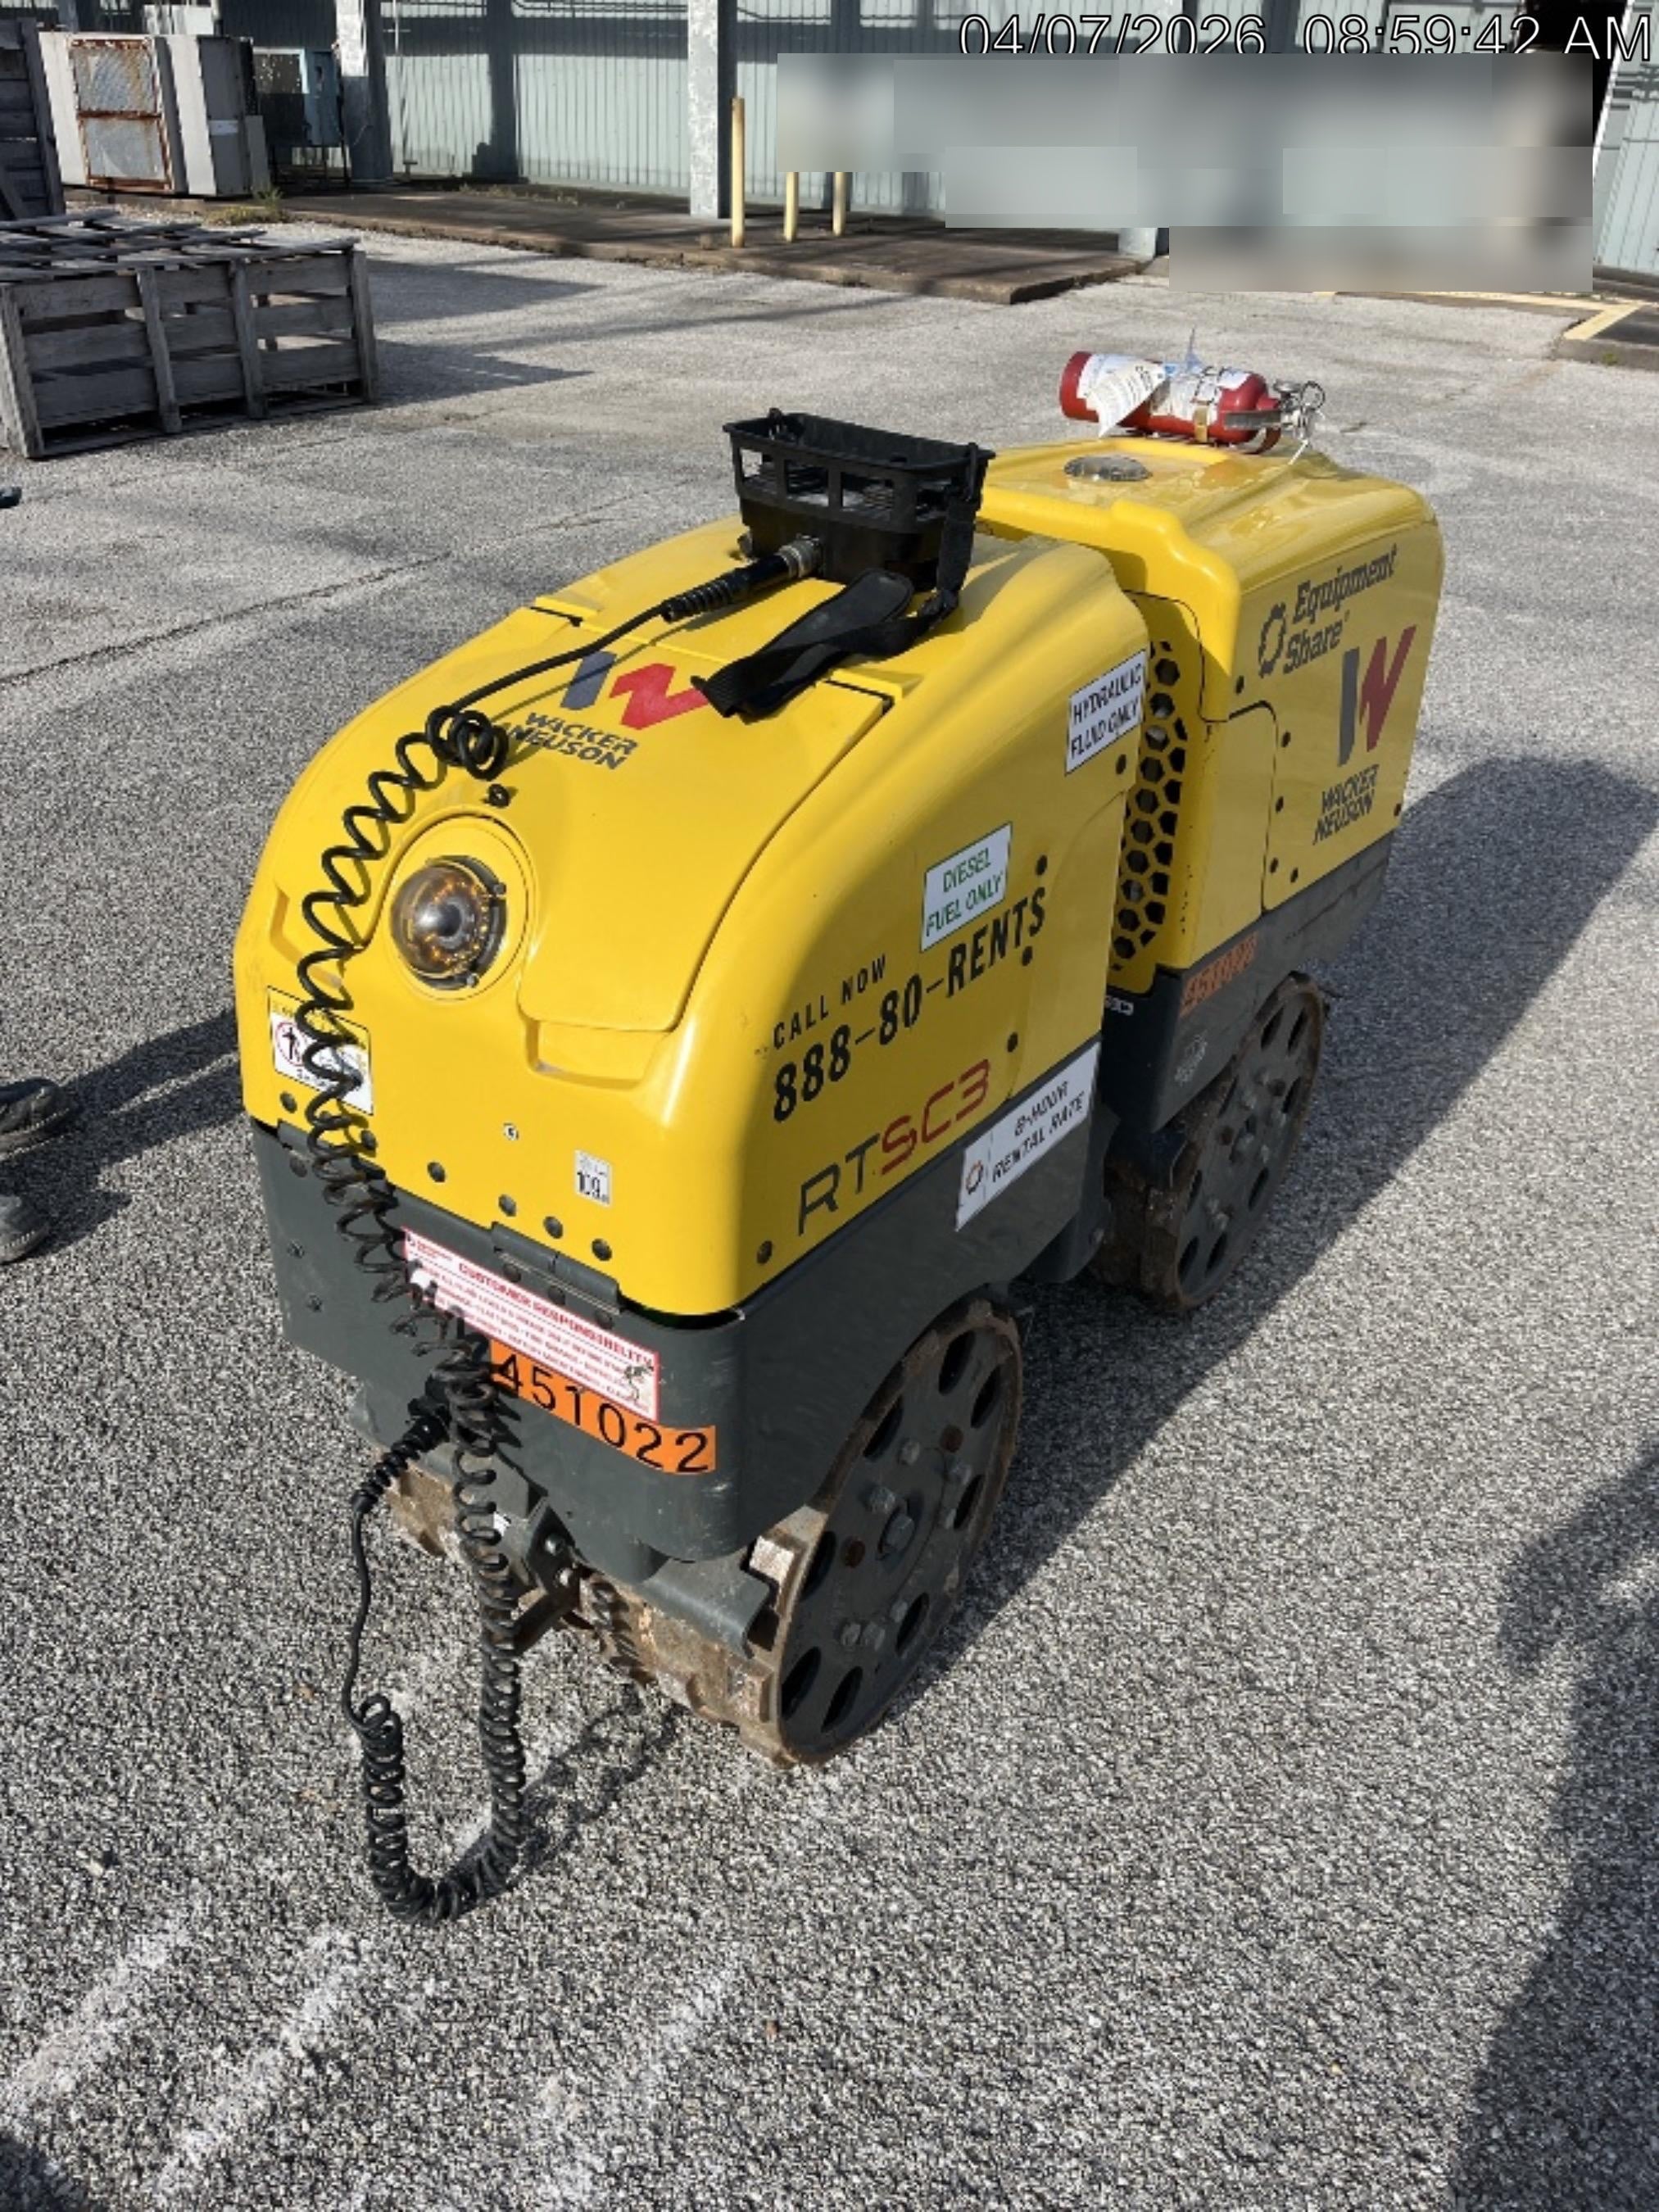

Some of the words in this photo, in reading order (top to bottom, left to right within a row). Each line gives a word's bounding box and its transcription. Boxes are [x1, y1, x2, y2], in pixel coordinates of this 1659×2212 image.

[1293, 543, 1397, 624] Equipment
[1283, 618, 1344, 674] Share
[1073, 662, 1142, 725] HYDRAULIC
[509, 724, 629, 770] NEUSON
[525, 712, 639, 757] WACKER
[1071, 718, 1106, 759] FLUID
[1108, 694, 1139, 735] ONLY
[1312, 789, 1376, 846] NEUSON
[1321, 764, 1380, 814] WACKER
[942, 847, 991, 895] DIESEL
[925, 900, 963, 938] FUEL
[965, 870, 1004, 911] ONLY
[773, 994, 830, 1050] CALL
[841, 953, 886, 1005] NOW
[773, 886, 1046, 1123] 888-80-RENTS
[992, 1125, 1046, 1183] RENTAL
[1049, 1090, 1085, 1135] RATE
[1014, 1081, 1069, 1137] 8-HOUR
[458, 1262, 533, 1308] CUSTOMER
[533, 1301, 655, 1367] RESPONSIBILITY
[493, 1353, 710, 1474] 451022
